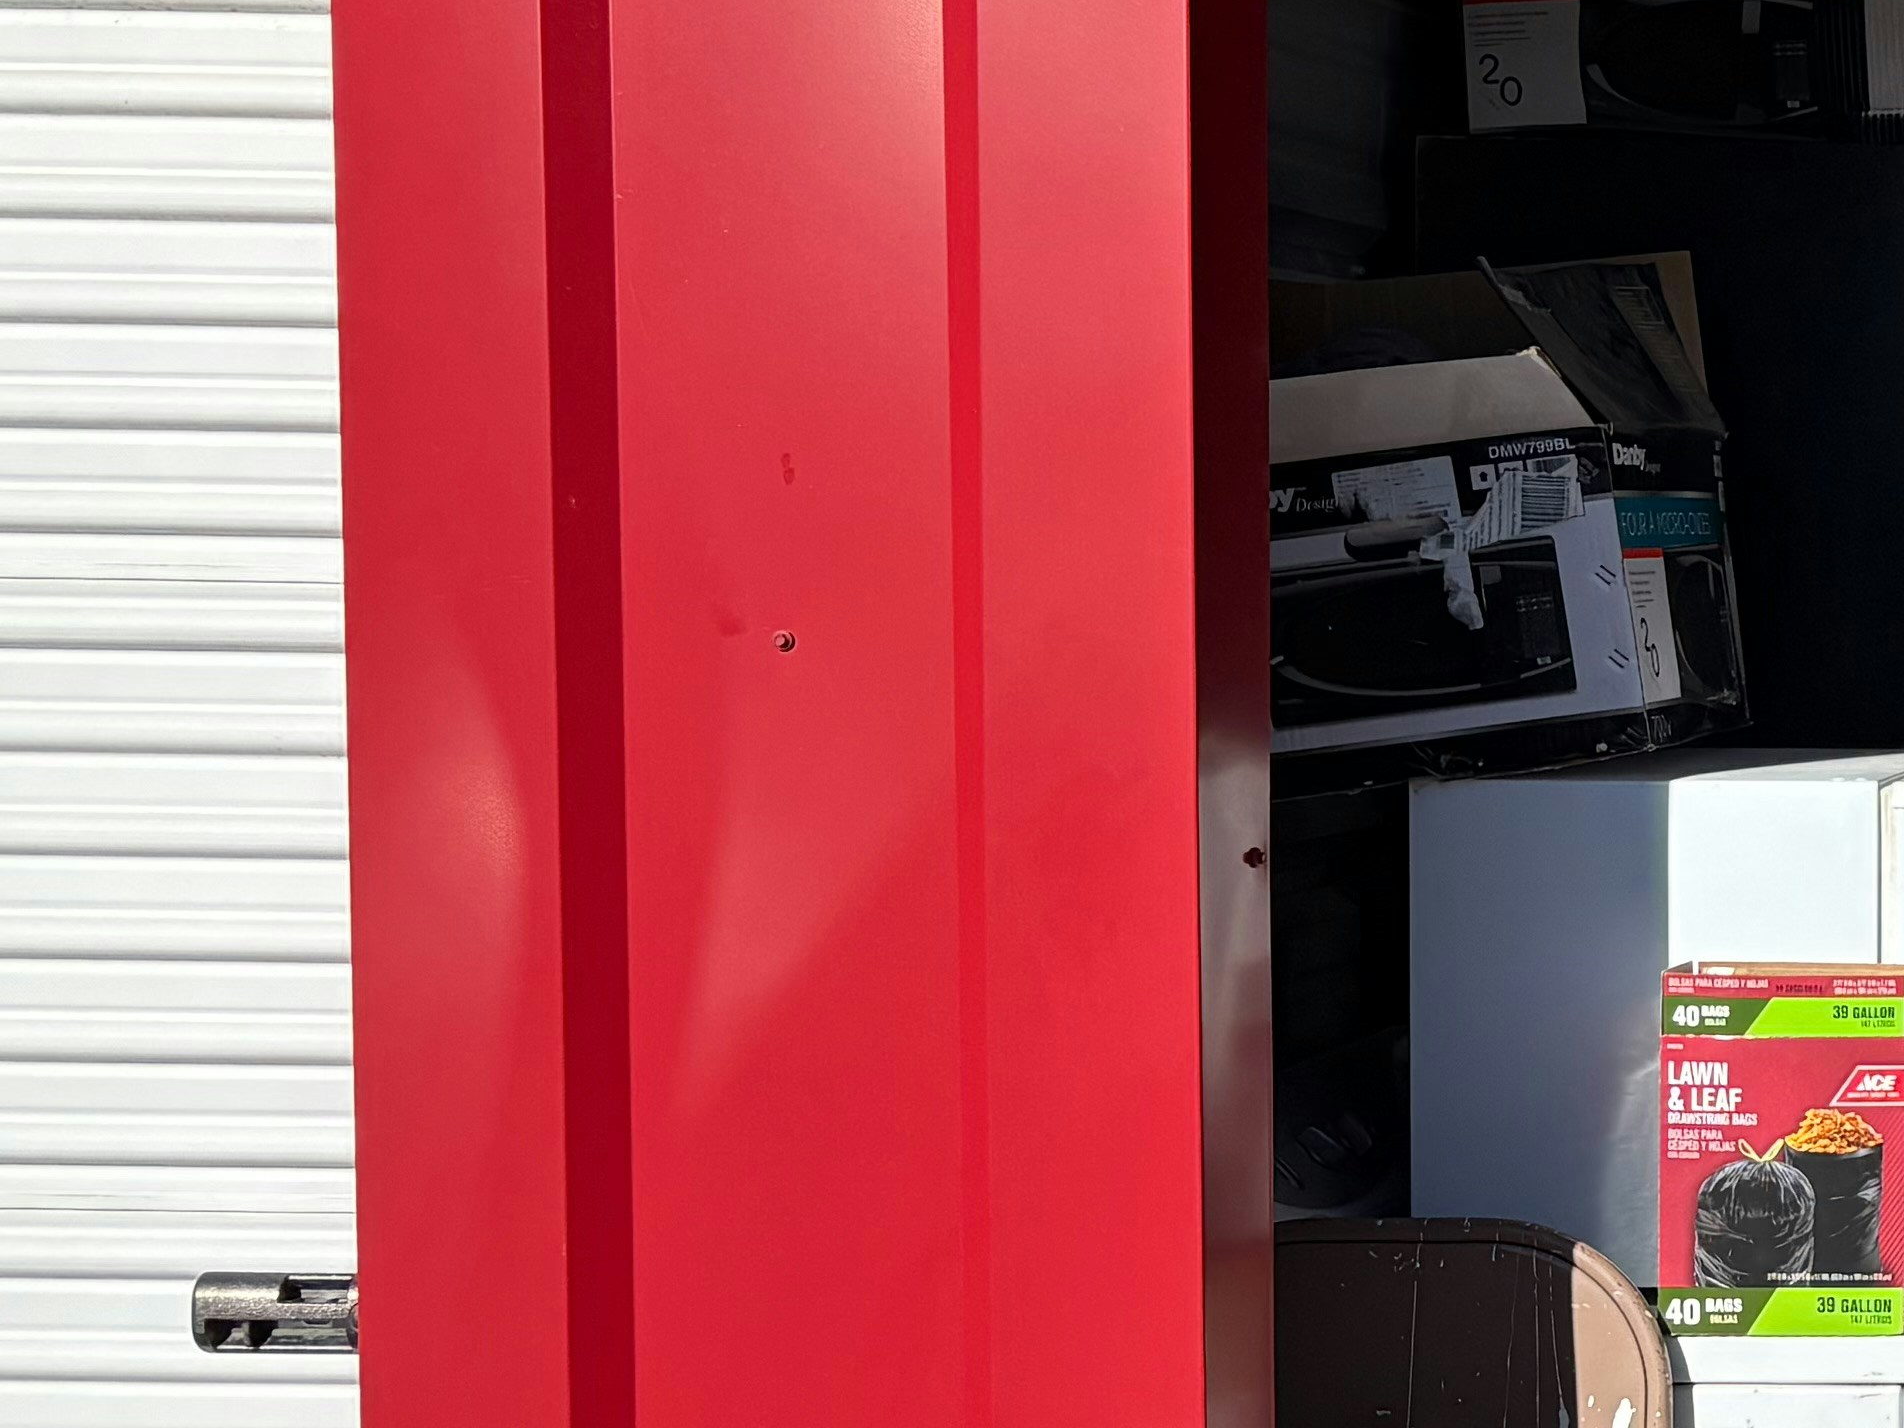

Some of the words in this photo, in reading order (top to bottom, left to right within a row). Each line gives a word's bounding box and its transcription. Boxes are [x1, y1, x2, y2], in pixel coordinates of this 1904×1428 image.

[1488, 437, 1577, 460] DMW799BL
[1672, 1005, 1700, 1026] 40
[1701, 1005, 1731, 1017] BAGS
[1832, 1005, 1849, 1019] 39
[1852, 1006, 1895, 1019] GALLON
[1667, 1060, 1728, 1086] LAWN
[1856, 1073, 1898, 1091] ACE
[1667, 1086, 1685, 1111] &
[1691, 1087, 1743, 1112] LEAF
[1667, 1111, 1730, 1125] DRAWSTRING
[1732, 1113, 1758, 1126] BAGS
[1665, 1298, 1701, 1325] 40
[1705, 1298, 1743, 1313] BAGS
[1817, 1297, 1835, 1313] 39
[1841, 1299, 1892, 1313] GALLON
